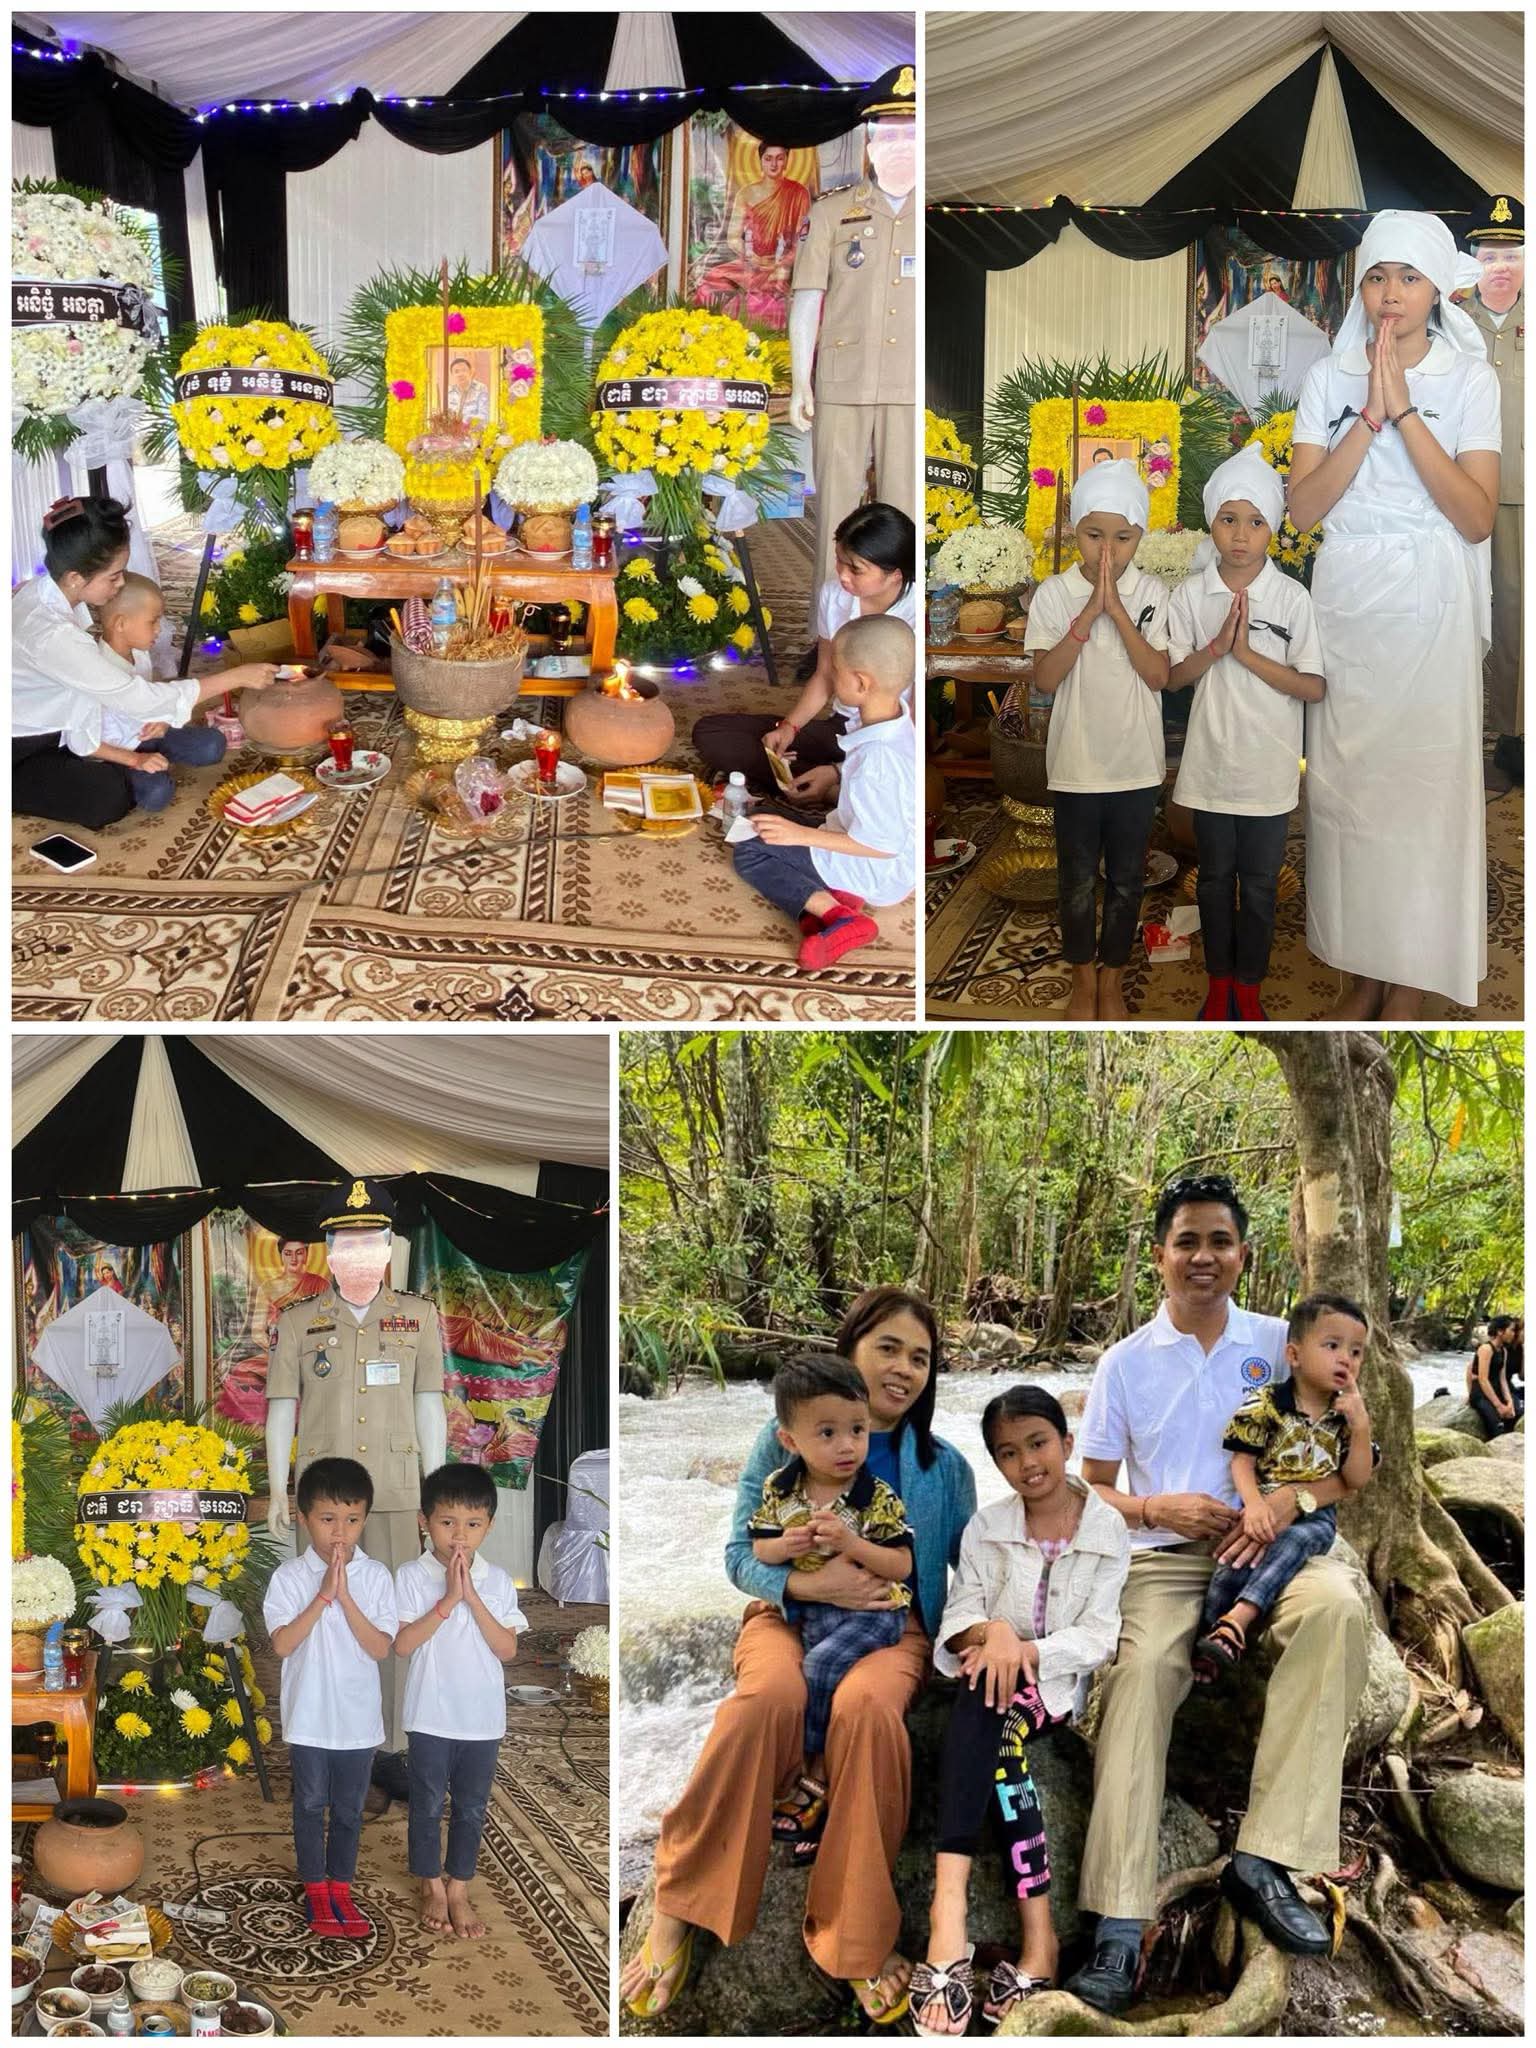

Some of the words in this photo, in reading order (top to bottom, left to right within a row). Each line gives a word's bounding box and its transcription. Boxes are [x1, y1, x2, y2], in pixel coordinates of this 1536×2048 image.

[62, 296, 105, 321] អនត្តា
[927, 465, 967, 486] អនត្តា
[200, 1499, 242, 1515] មរណៈ
